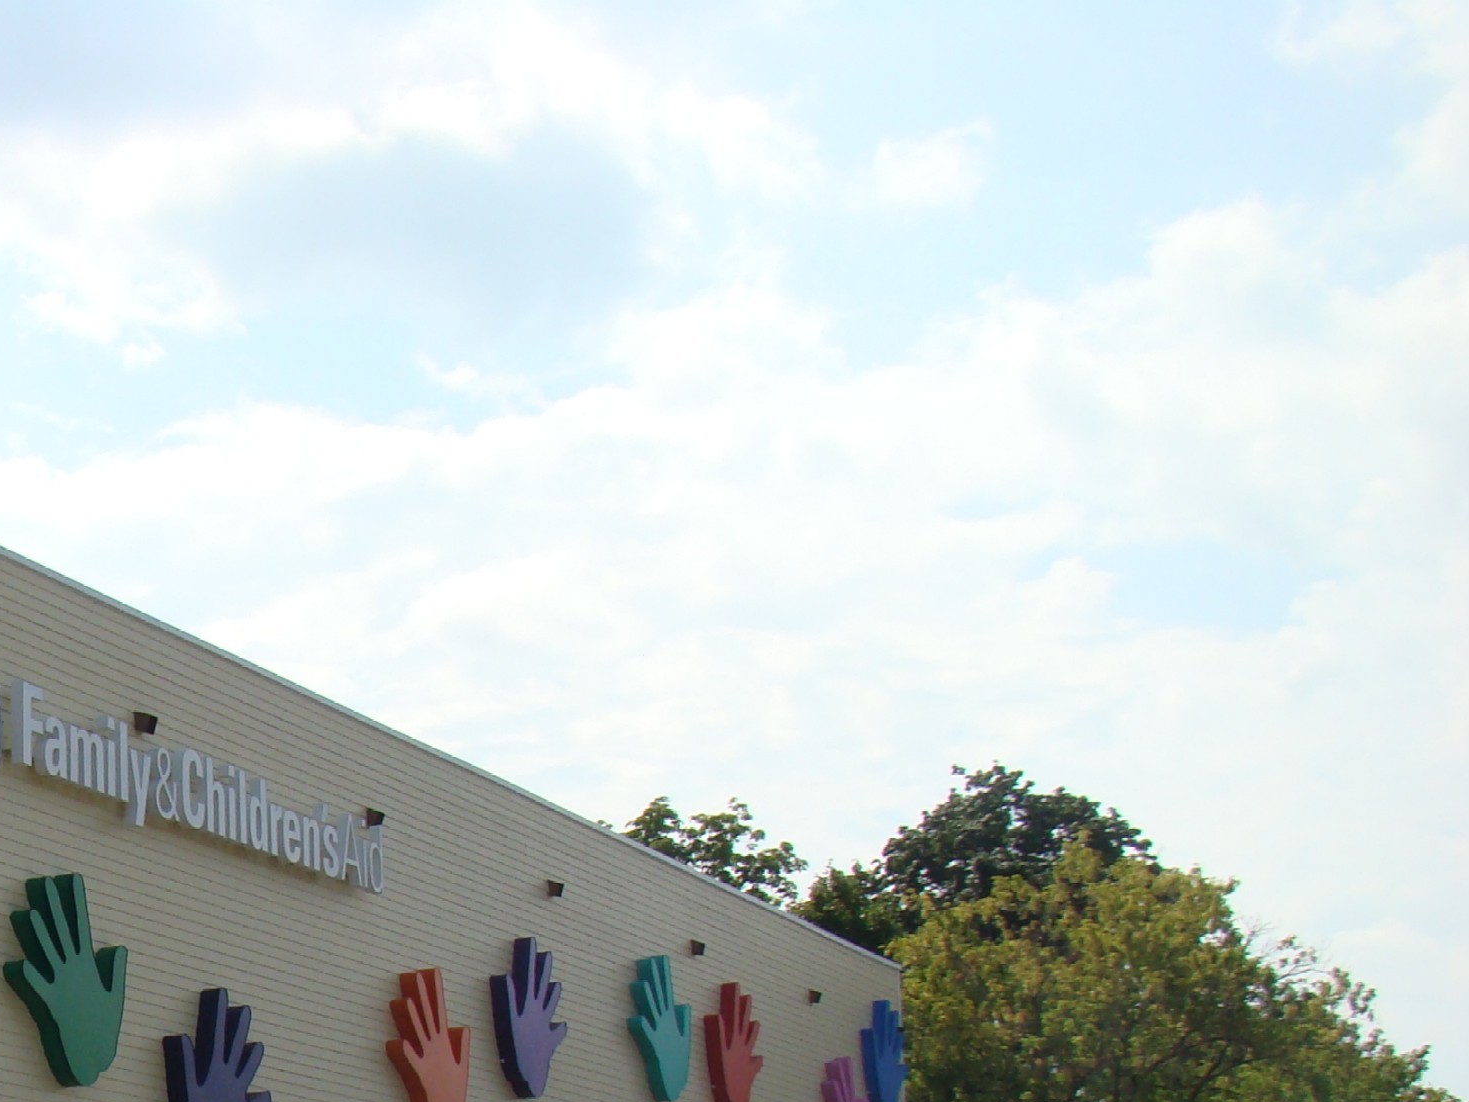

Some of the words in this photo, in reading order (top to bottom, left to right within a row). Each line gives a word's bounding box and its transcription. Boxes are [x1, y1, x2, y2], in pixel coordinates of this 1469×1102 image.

[12, 680, 151, 827] Family
[154, 745, 180, 822] &
[339, 811, 385, 893] Aid
